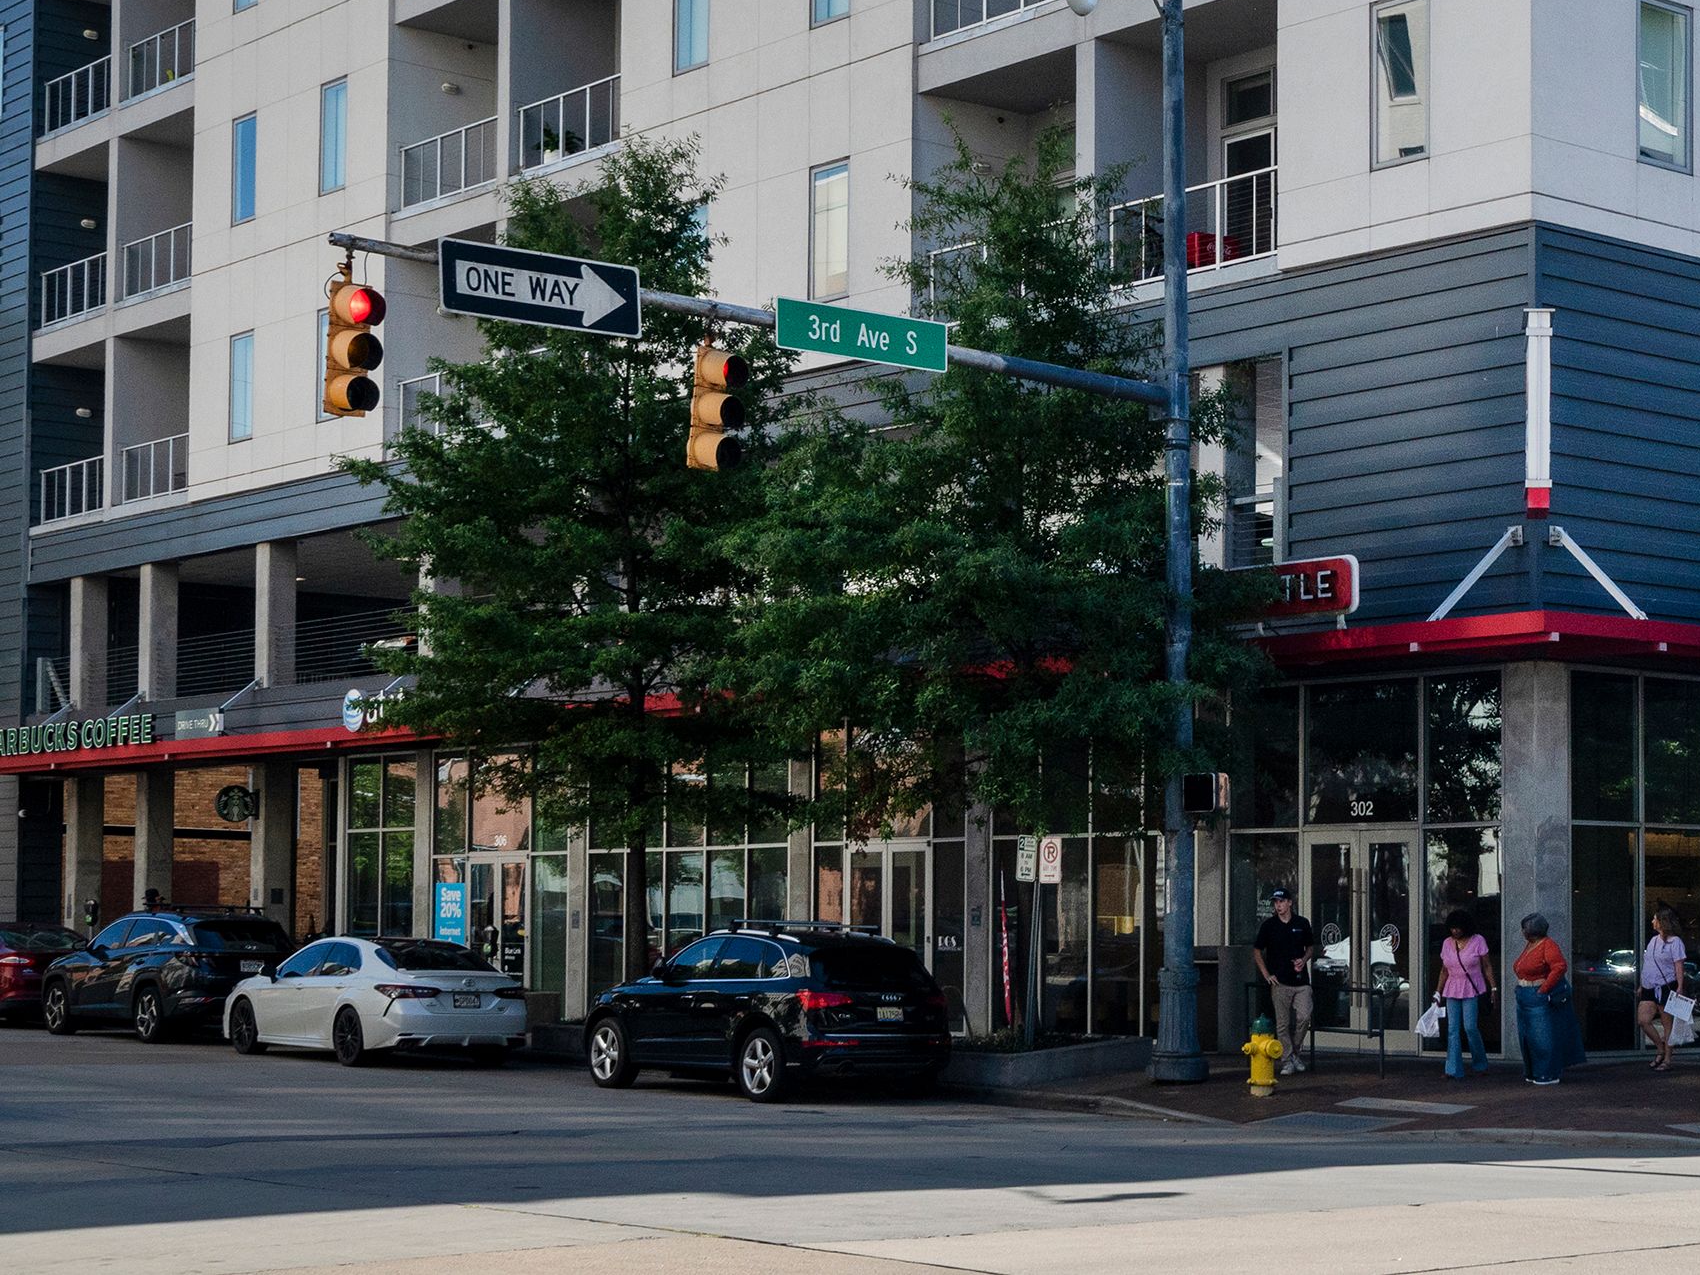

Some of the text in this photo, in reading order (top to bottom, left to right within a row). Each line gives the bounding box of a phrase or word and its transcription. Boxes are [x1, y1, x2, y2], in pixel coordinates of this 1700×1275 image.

[466, 266, 580, 306] ONE WAY
[808, 314, 917, 355] 3rd Ave S
[81, 713, 153, 749] COFFEE
[1350, 801, 1374, 816] 302
[493, 834, 508, 847] 306
[441, 887, 461, 902] Save
[440, 902, 462, 918] 20%
